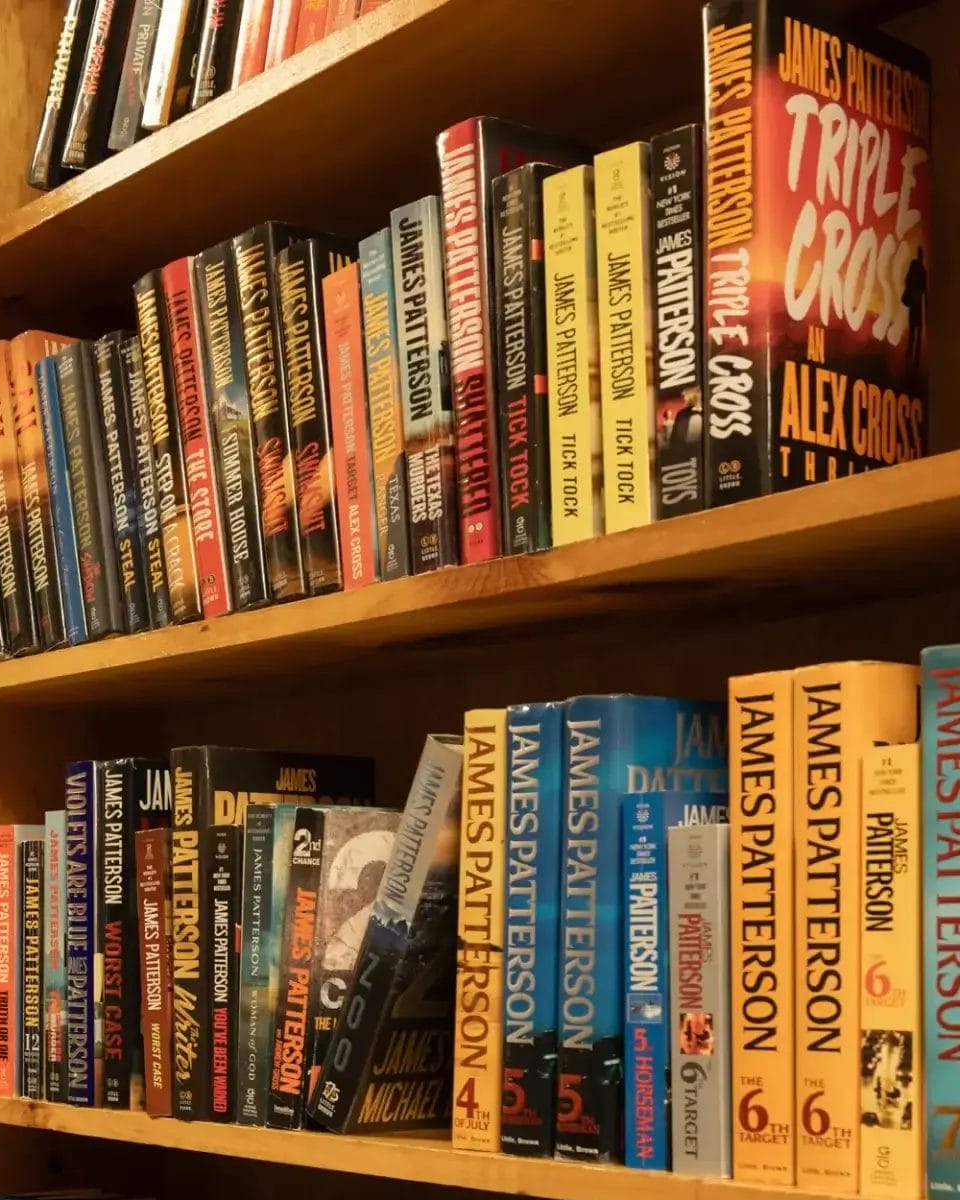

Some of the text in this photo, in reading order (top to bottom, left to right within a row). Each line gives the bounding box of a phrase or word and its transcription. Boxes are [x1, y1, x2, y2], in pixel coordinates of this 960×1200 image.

[779, 16, 929, 138] JAMES PATTERSON
[785, 93, 928, 242] TRIPLE
[607, 252, 631, 303] JAMES
[656, 228, 693, 256] JAMES
[708, 22, 753, 441] JAMES PATTERSON TRIPLE CROSS
[784, 200, 914, 347] CROSS
[398, 217, 434, 422] JAMES PATTERSON
[554, 272, 576, 327] JAMES
[657, 248, 696, 390] PATTERSON
[807, 325, 826, 365] AN
[501, 225, 530, 511] JAMES PATTERSON TICK TOCK
[556, 329, 579, 417] PATTERSON
[610, 310, 635, 401] PATTERSON
[205, 260, 249, 564] JAMES PATTERSON SUMMER HOUSE
[561, 433, 577, 471] TICK
[615, 417, 633, 457] TICK
[780, 361, 923, 466] ALEX CROSS
[389, 475, 400, 523] TEXAS
[407, 451, 427, 524] MURDERS
[424, 445, 442, 520] THE TEXAS
[563, 476, 578, 518] TOCK
[617, 460, 635, 505] TOCK
[661, 456, 699, 505] TOYS
[65, 772, 88, 951] VIOLETS ARE BLUE
[459, 723, 497, 1072] JAMES PATTERSON
[504, 722, 540, 1047] JAMES PATTERSON
[561, 719, 601, 1052] JAMES PATTERSON
[735, 692, 778, 1053] JAMES PATTERSON
[802, 682, 842, 1054] JAMES PATTERSON
[864, 811, 895, 933] PATTERSON
[103, 769, 123, 1060] JAMES PATTERSON WORST CASE
[629, 884, 659, 992] PATTERSON
[68, 976, 88, 1088] PATTERSON
[633, 1055, 655, 1160] HORSEMAN
[684, 1085, 699, 1159] TARGET
[739, 1132, 790, 1146] TARGET
[802, 1135, 853, 1150] TARGET
